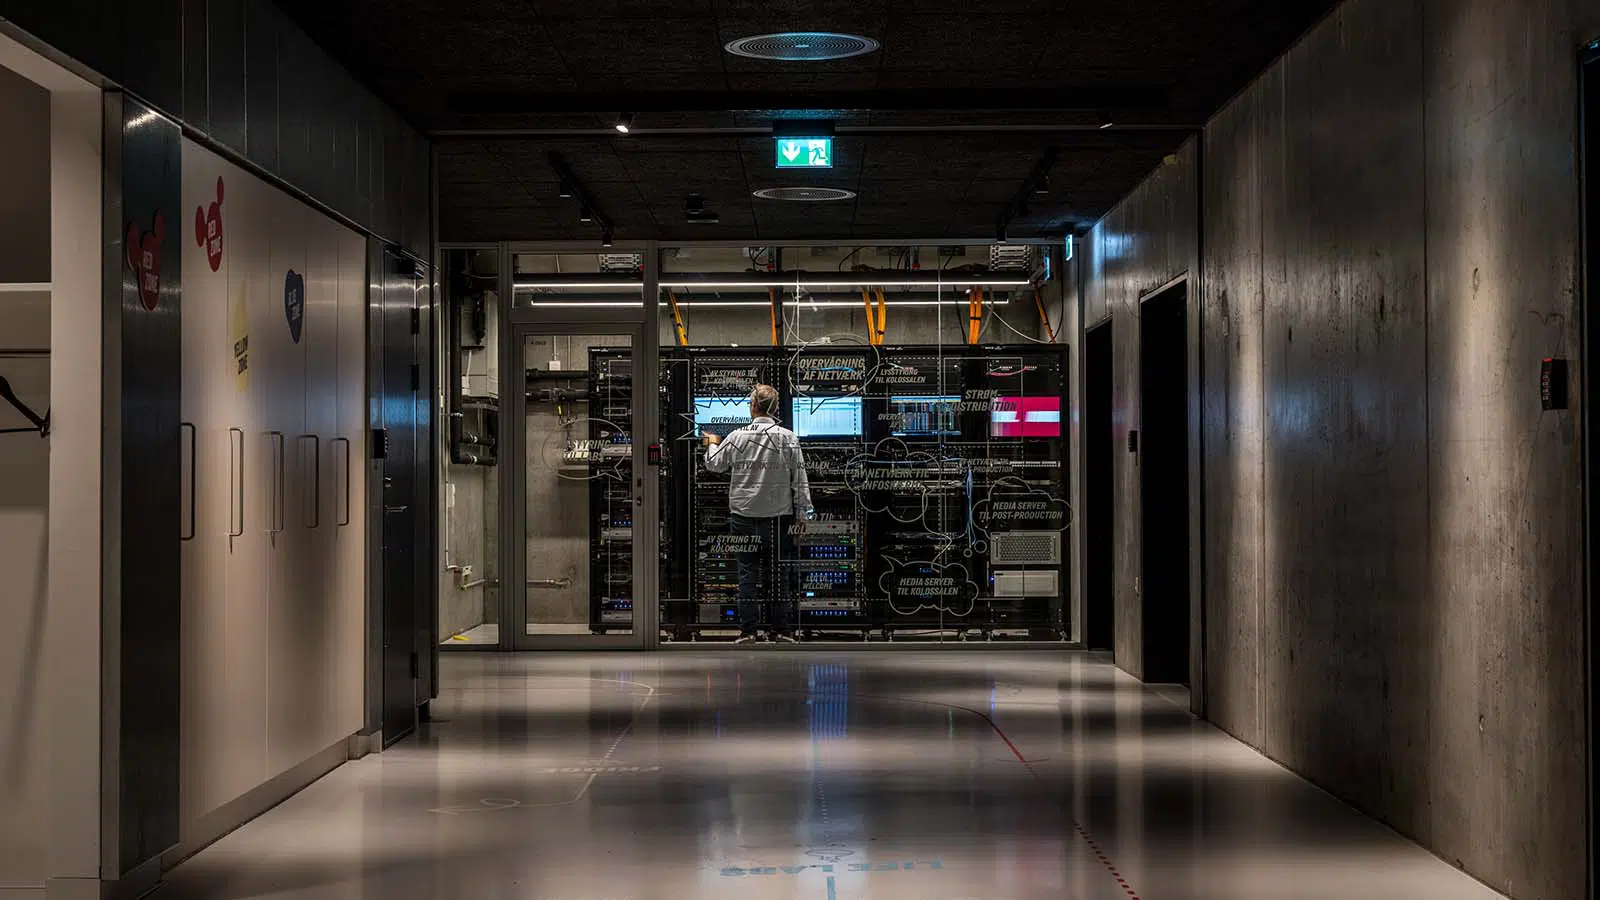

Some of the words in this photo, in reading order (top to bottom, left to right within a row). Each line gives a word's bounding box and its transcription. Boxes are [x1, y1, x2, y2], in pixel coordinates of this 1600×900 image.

[800, 357, 865, 369] OVERVÅGNING
[803, 372, 816, 381] AF
[818, 372, 864, 381] NETVÆRK
[993, 502, 1016, 510] MEDIA
[1017, 502, 1047, 510] SERVER
[978, 511, 991, 519] TIL
[991, 511, 1063, 519] POST-PRODUCTION
[706, 535, 716, 543] AV
[716, 535, 748, 543] STYRING
[750, 535, 762, 543] TIL
[900, 578, 924, 586] MEDIA
[925, 578, 954, 586] SERVER
[897, 587, 909, 595] TIL
[910, 587, 959, 595] KOLOSSALEN
